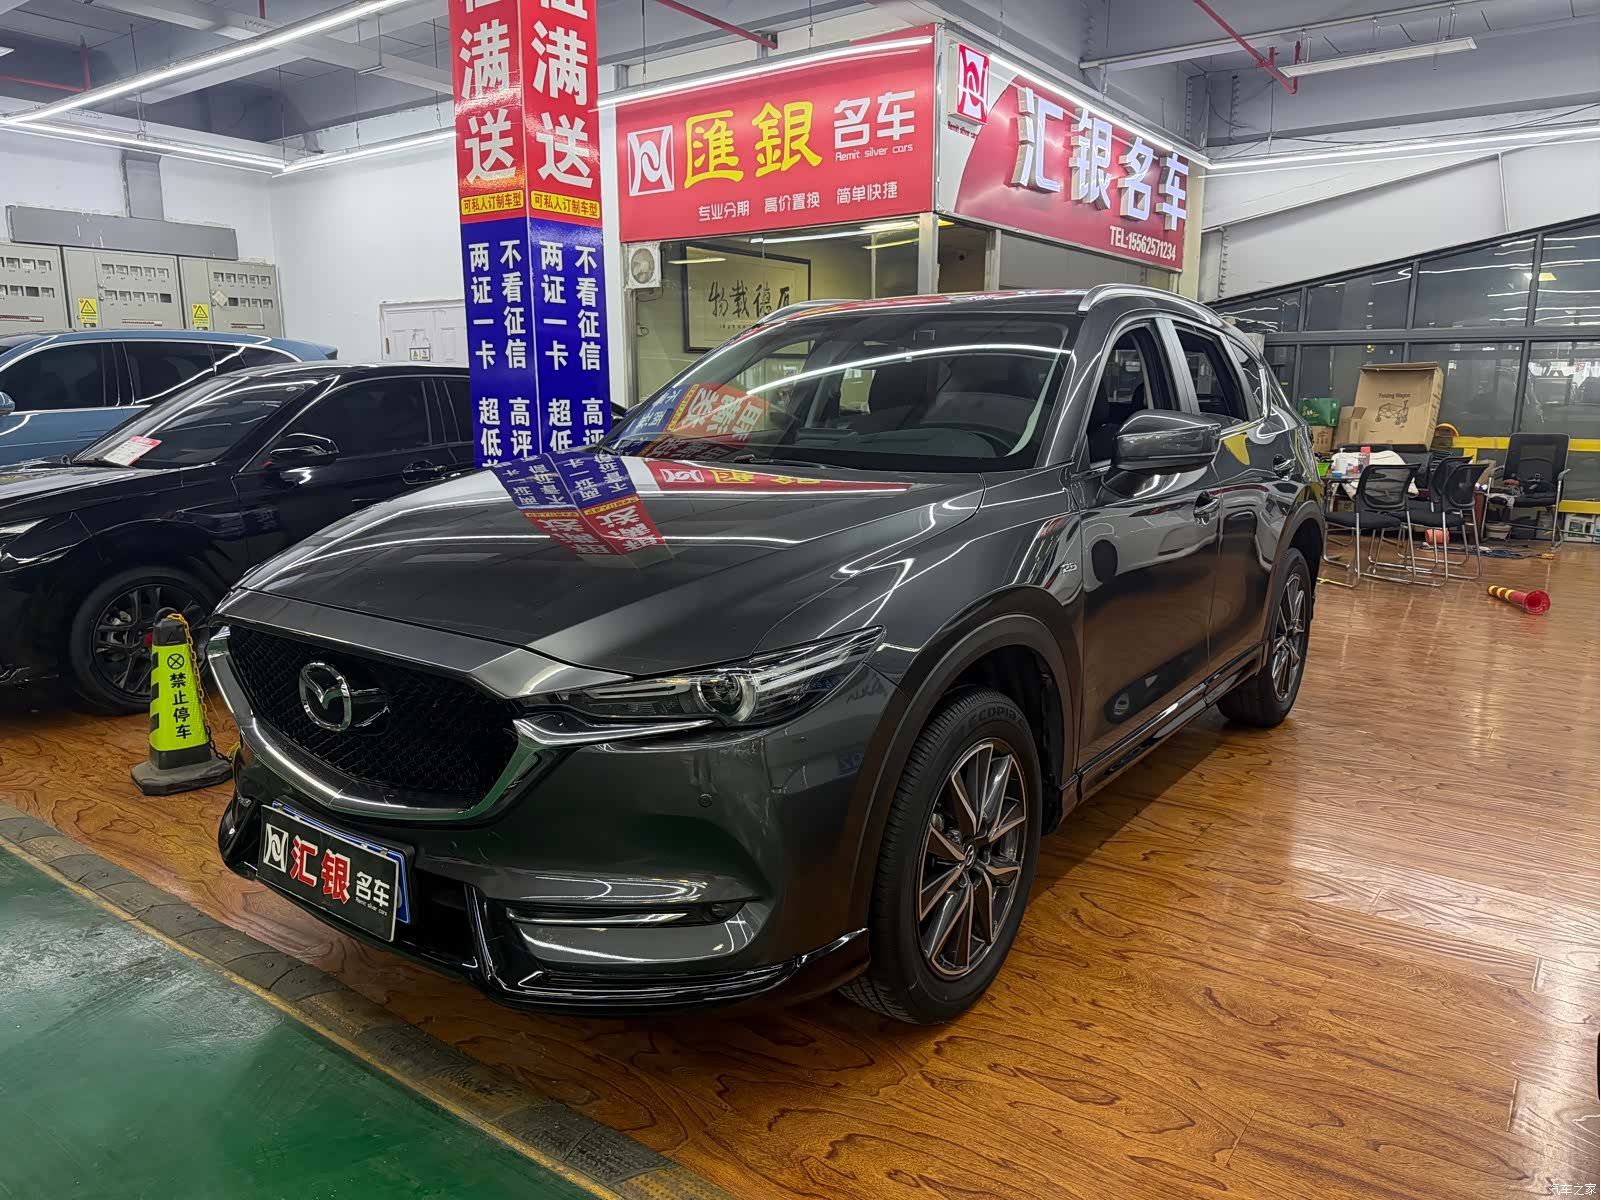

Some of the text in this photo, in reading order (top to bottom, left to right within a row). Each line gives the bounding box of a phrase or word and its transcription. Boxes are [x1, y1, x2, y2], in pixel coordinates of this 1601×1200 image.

[459, 0, 517, 185] 满送
[531, 0, 594, 189] 满送
[684, 91, 915, 189] 匯銀 名车
[864, 147, 888, 159] silver
[892, 144, 913, 154] cars
[1012, 86, 1189, 231] 汇银名车
[463, 191, 522, 211] 可私人订制车型
[533, 192, 598, 217] 可私人订制车型
[698, 181, 898, 222] 专业分期 高价置换 简单快捷
[1110, 225, 1176, 262] TEL:15562571234
[468, 242, 496, 371] 两证一卡
[499, 239, 533, 458] 不看征信 高评
[539, 240, 569, 371] 两证一卡
[574, 245, 601, 371] 不看征信
[169, 672, 192, 740] 禁止停车
[290, 835, 390, 907] 汇银 名车
